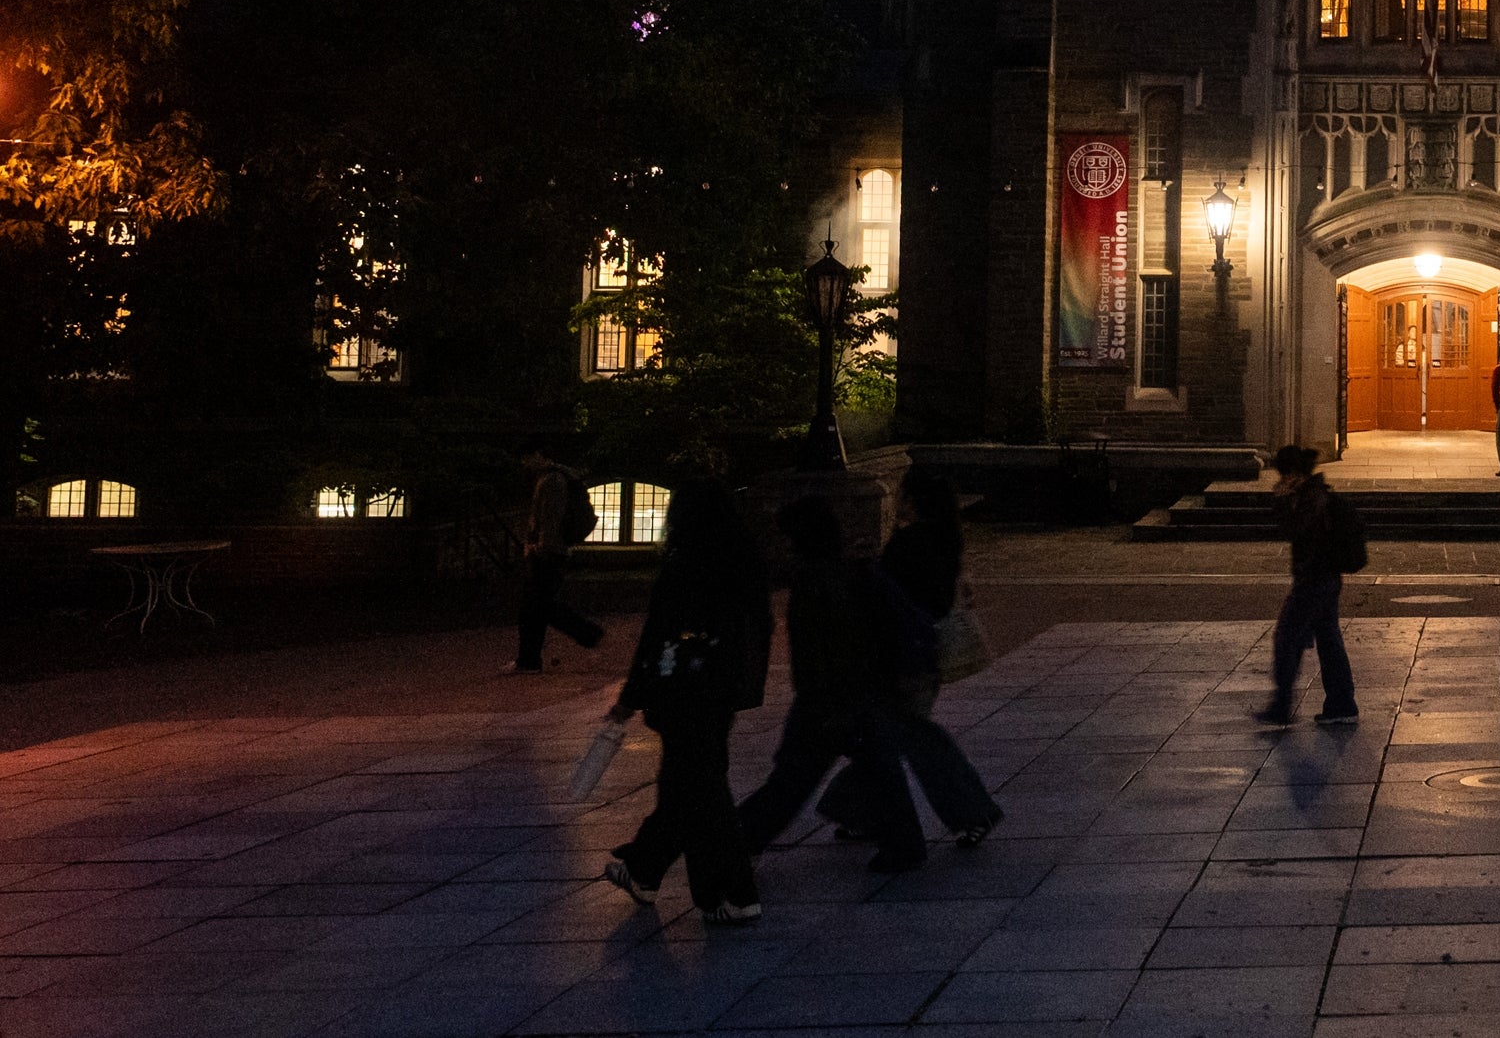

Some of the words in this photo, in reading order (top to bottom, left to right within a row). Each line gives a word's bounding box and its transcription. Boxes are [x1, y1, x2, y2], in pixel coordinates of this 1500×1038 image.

[1092, 145, 1124, 171] UNIVERSITY
[1099, 236, 1110, 259] Hall
[1110, 211, 1128, 271] Union
[1099, 263, 1112, 312] Straight
[1097, 315, 1109, 359] Willard
[1110, 277, 1127, 360] Student
